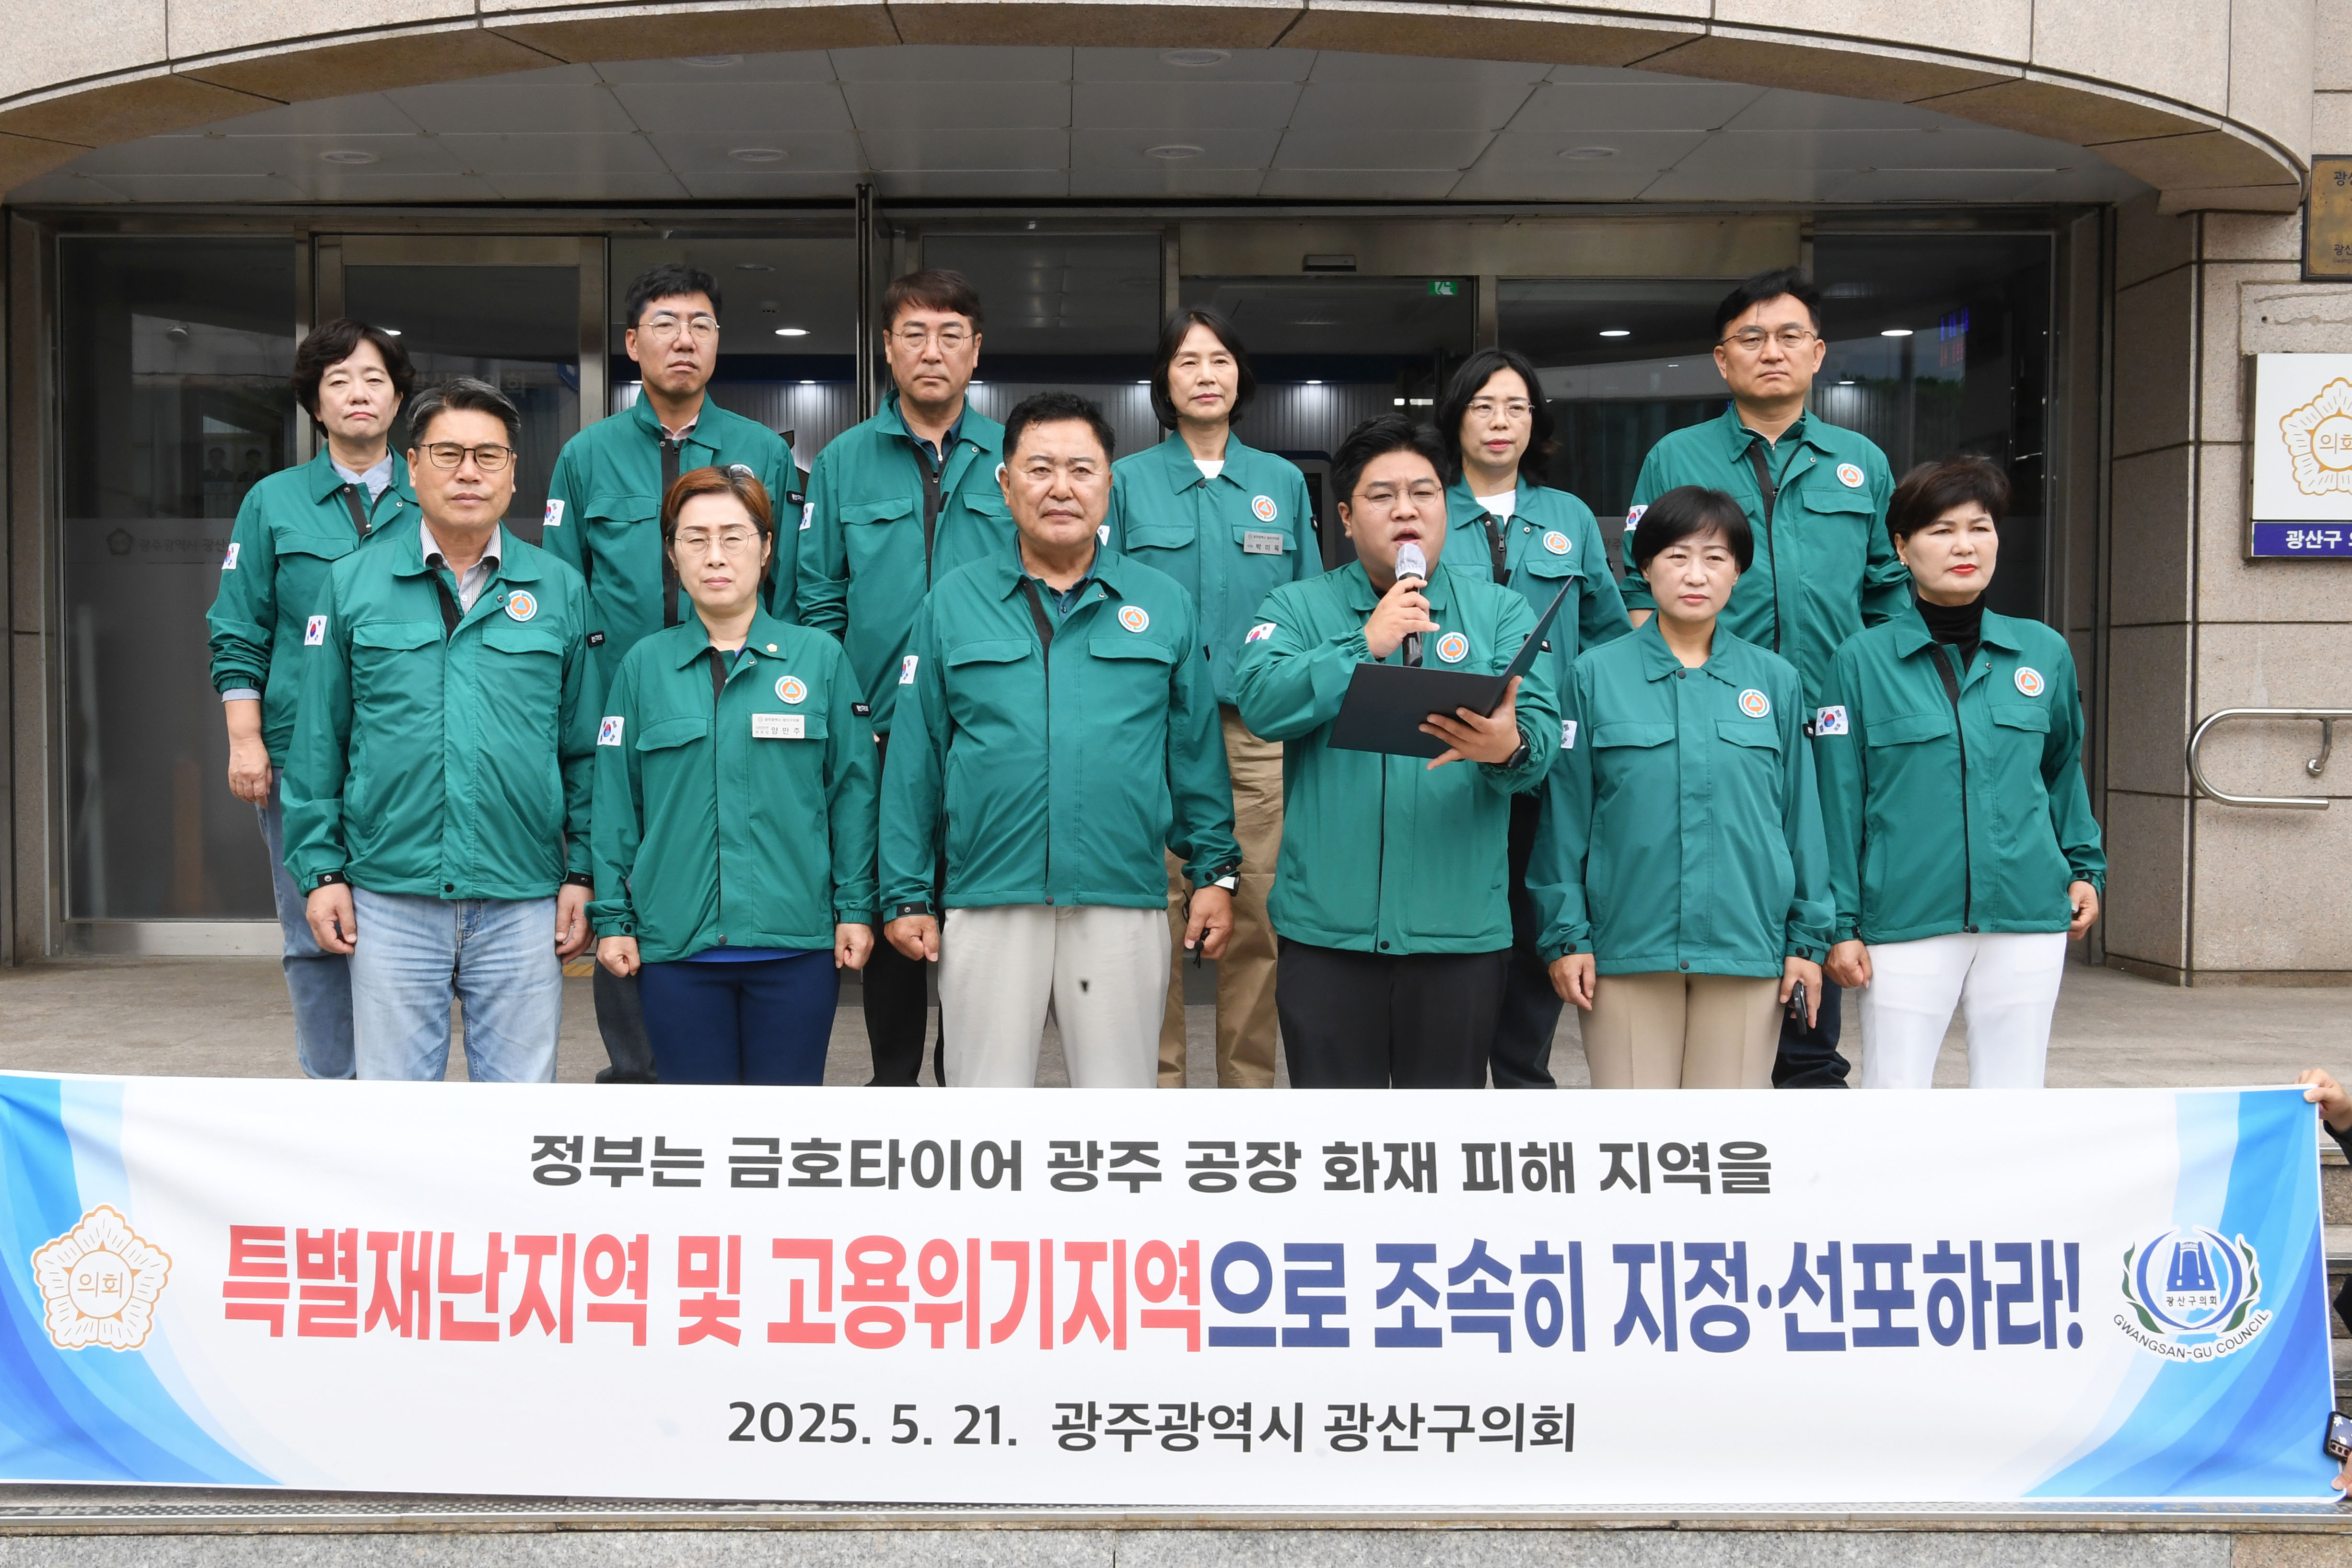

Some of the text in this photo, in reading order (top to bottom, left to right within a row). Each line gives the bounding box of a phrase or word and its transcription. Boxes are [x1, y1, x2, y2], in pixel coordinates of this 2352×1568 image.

[203, 538, 229, 552] 광산
[2285, 530, 2342, 549] 광산구
[531, 1136, 1771, 1194] 정부는 금호타이어 광주 공장 화재 피해 지역을
[77, 1271, 123, 1298] 의회
[222, 1225, 649, 1346] 특별재난지역
[678, 1235, 741, 1347] 및
[768, 1235, 1350, 1352] 고용위기지역으로
[1374, 1238, 1585, 1353] 조속히
[2166, 1295, 2217, 1306] 광산구의회
[2113, 1312, 2269, 1359] GWANGSAN-GU COUNCIL
[729, 1401, 1575, 1452] 2025. 5. 21. 광주광역시 광산구의회
